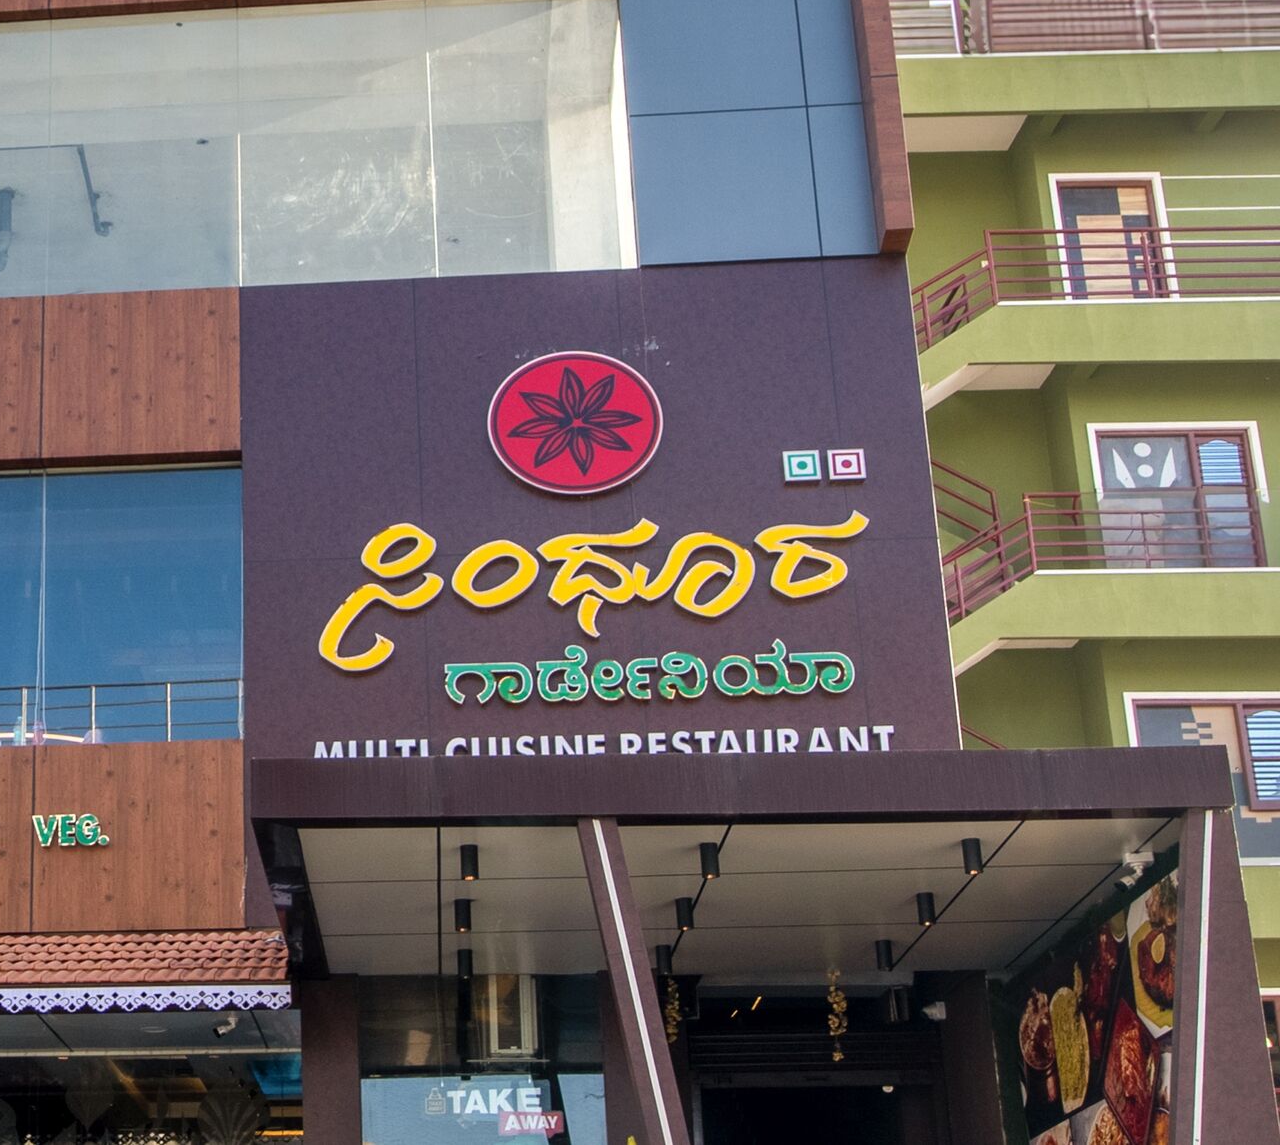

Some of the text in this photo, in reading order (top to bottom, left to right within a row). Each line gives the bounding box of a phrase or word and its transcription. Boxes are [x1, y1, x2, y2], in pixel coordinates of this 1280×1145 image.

[318, 509, 870, 672] ಸಿಂಧೂರ
[32, 813, 110, 847] VEG.
[446, 1087, 542, 1115] TAKE
[504, 1114, 558, 1131] AWAY
